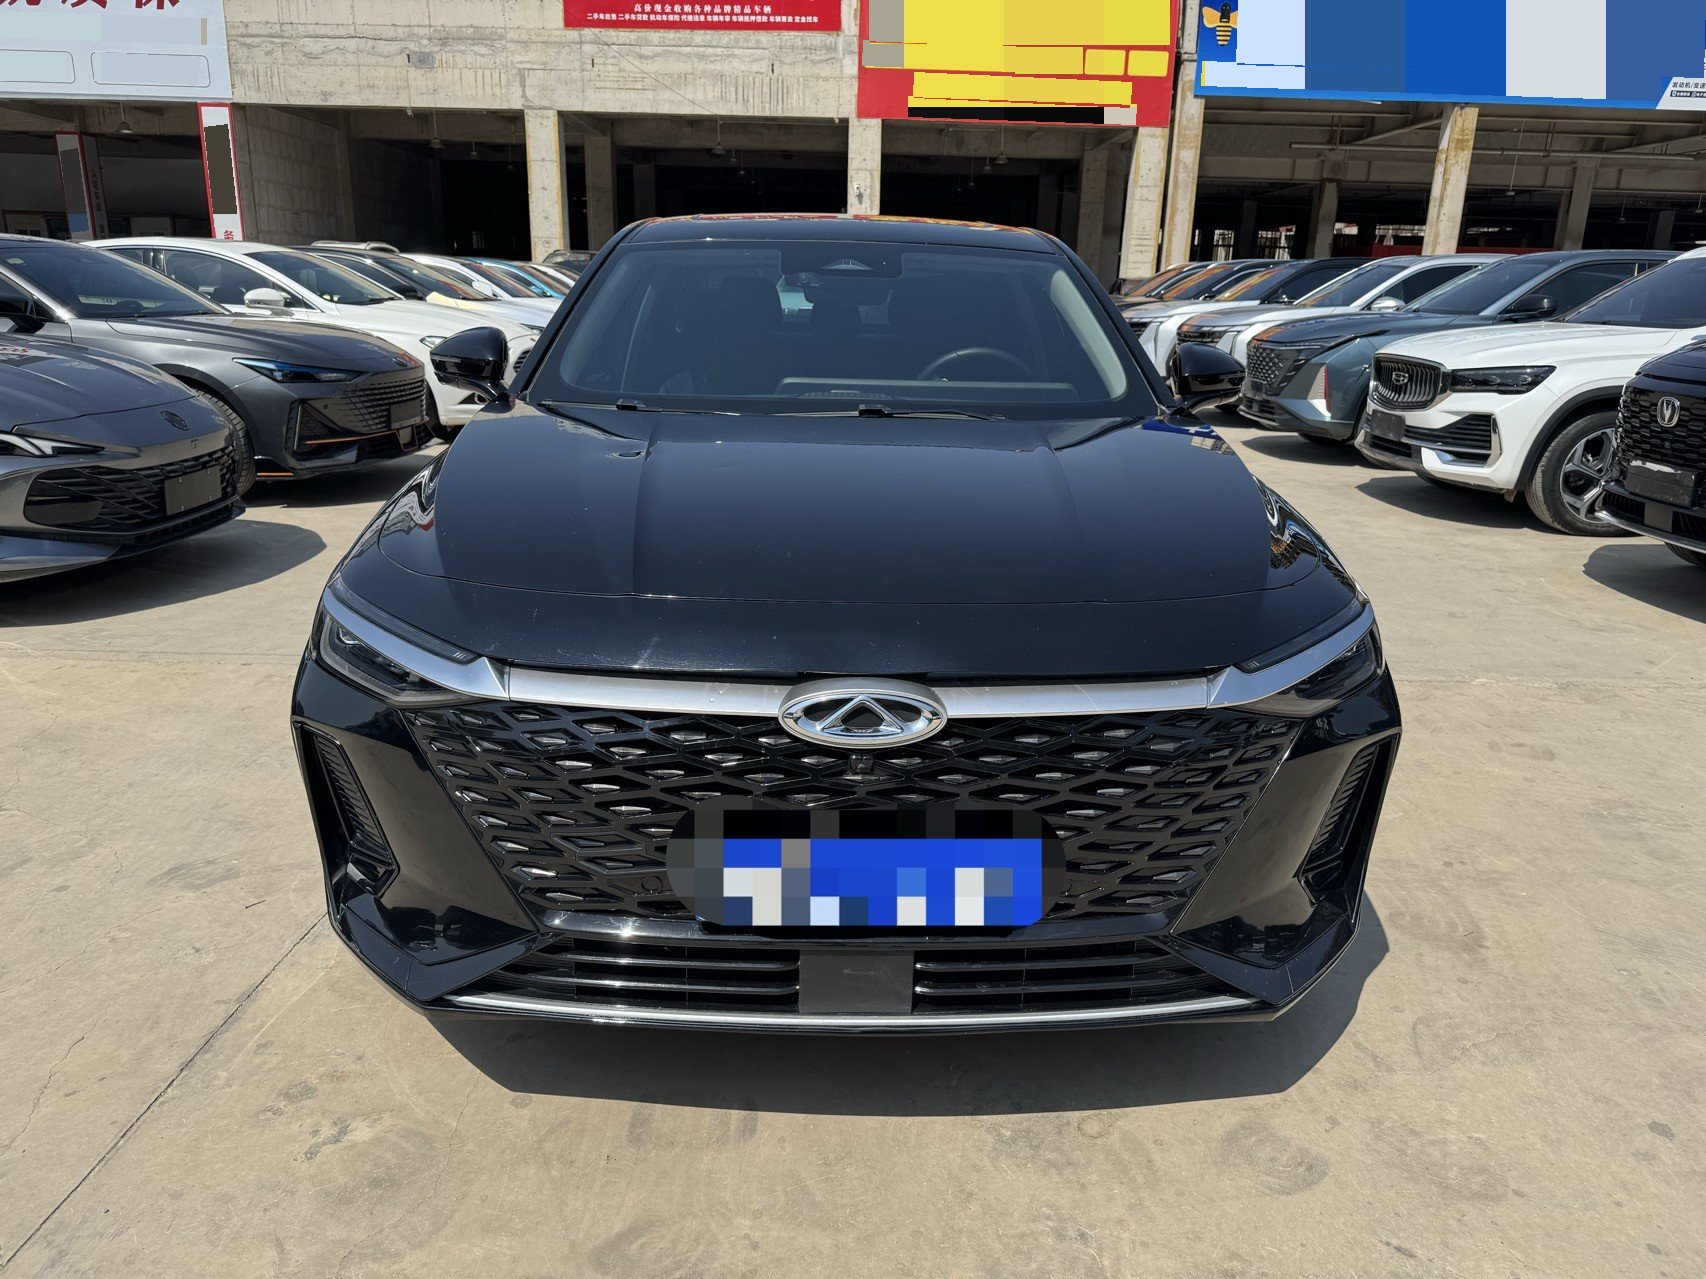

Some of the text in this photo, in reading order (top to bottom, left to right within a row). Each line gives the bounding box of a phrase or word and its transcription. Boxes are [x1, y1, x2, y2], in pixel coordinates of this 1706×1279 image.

[634, 4, 771, 14] 高价现金收购各种品牌精品车辆
